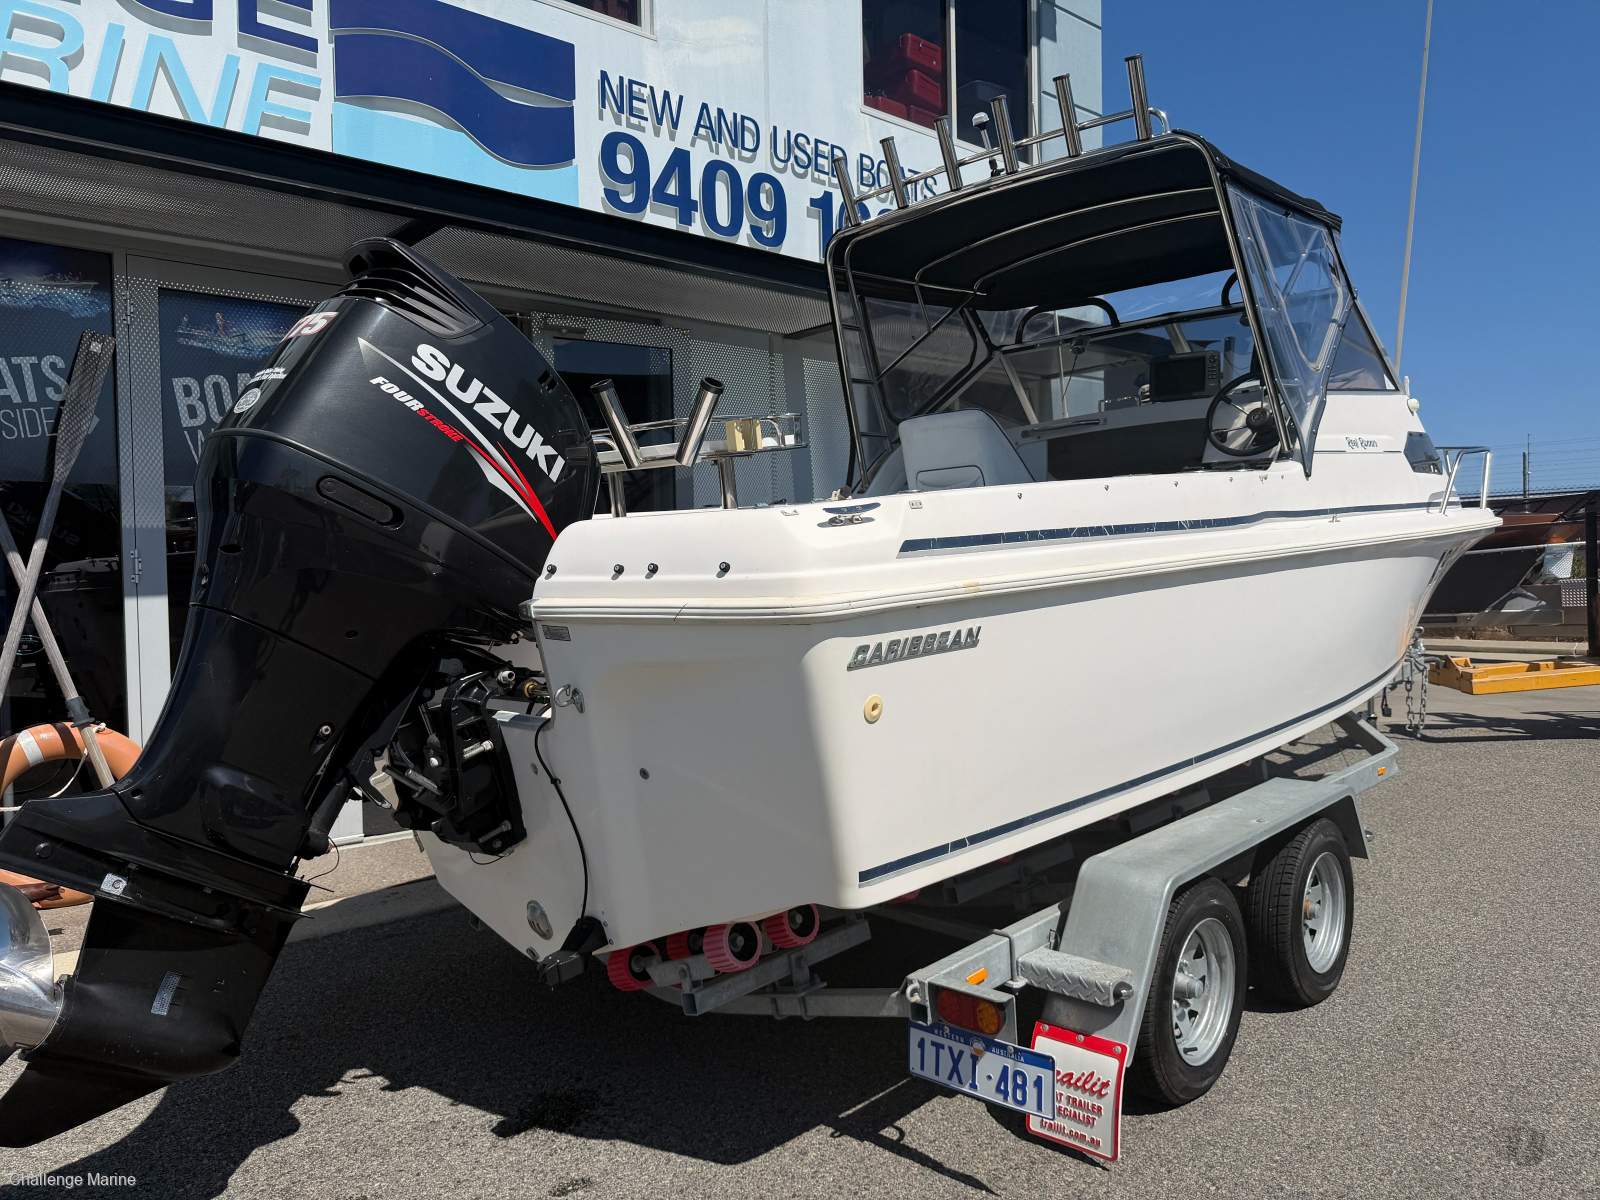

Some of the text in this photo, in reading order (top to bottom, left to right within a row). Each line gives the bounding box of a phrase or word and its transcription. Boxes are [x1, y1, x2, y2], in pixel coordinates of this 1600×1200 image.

[600, 69, 938, 204] NEW AND USED BOTS
[600, 131, 788, 248] 9409
[411, 343, 566, 484] SUZUKI
[849, 625, 982, 667] CARIBBEAN
[1056, 1105, 1098, 1126] ECIALIST
[1066, 1094, 1104, 1116] TRAILER
